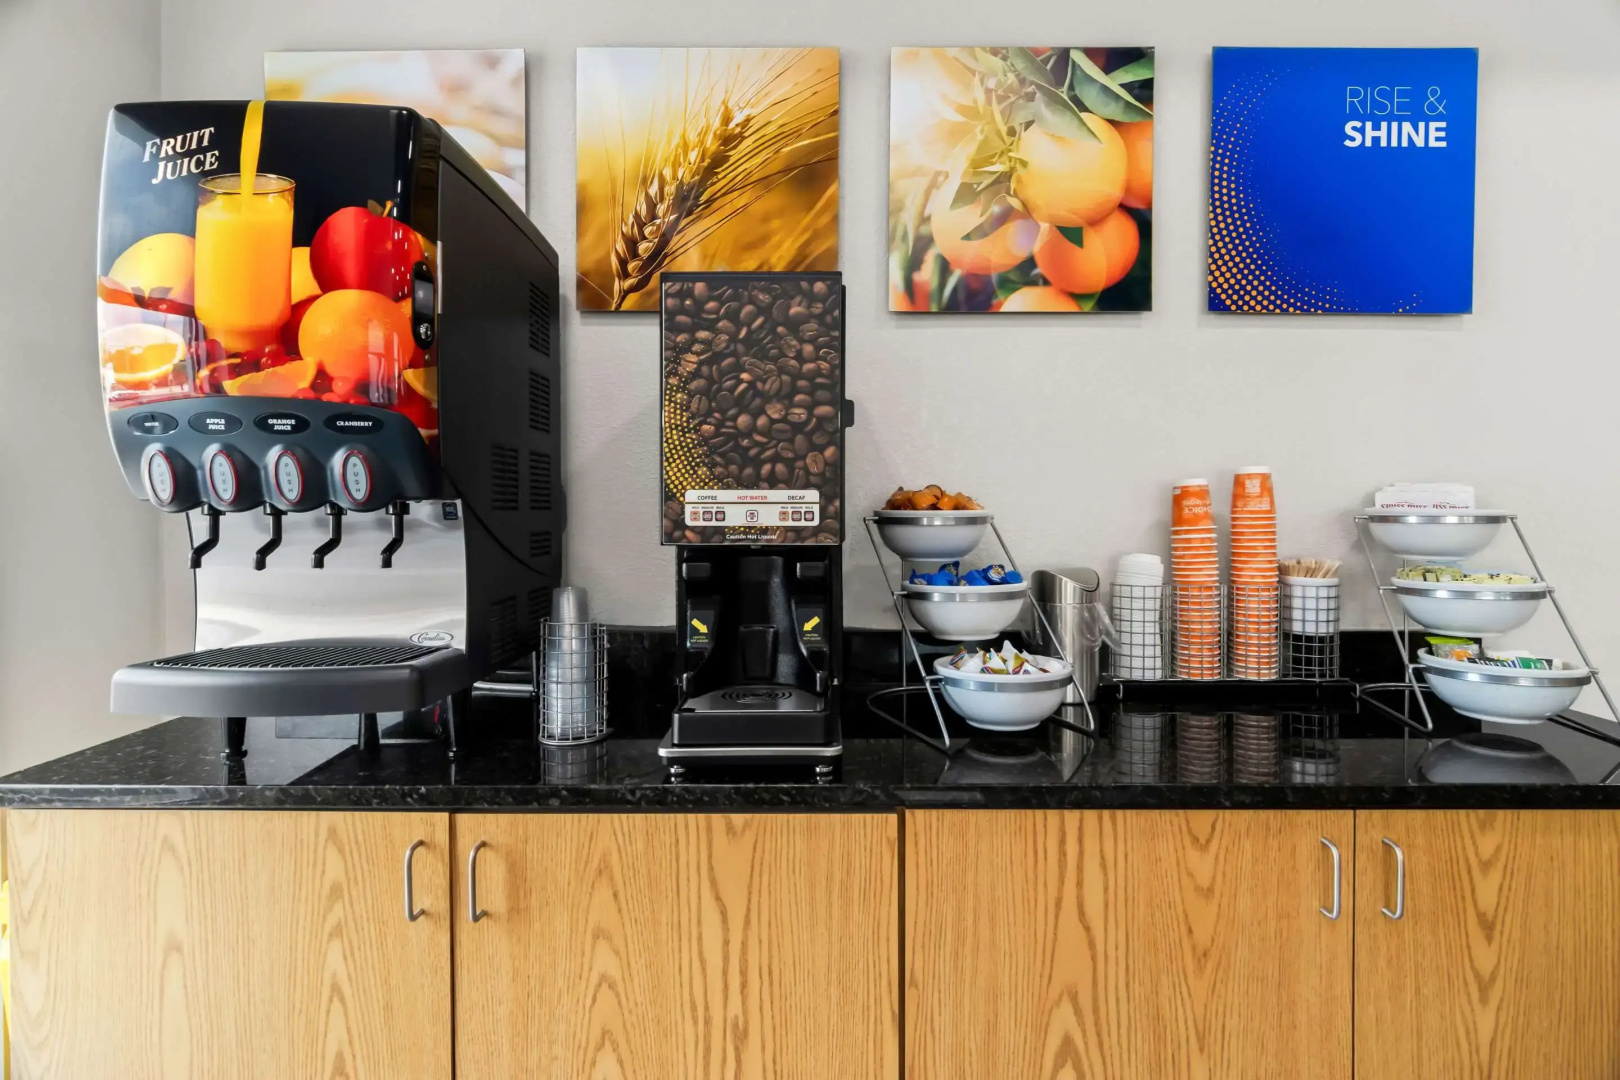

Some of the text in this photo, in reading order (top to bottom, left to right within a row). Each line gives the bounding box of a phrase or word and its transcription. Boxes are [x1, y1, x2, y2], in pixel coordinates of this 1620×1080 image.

[1346, 86, 1447, 115] RISE &
[142, 127, 215, 163] FRUIT
[1343, 120, 1447, 148] SHINE
[151, 150, 220, 185] JUICE
[284, 462, 294, 493] PUSH
[352, 462, 361, 493] PUSH
